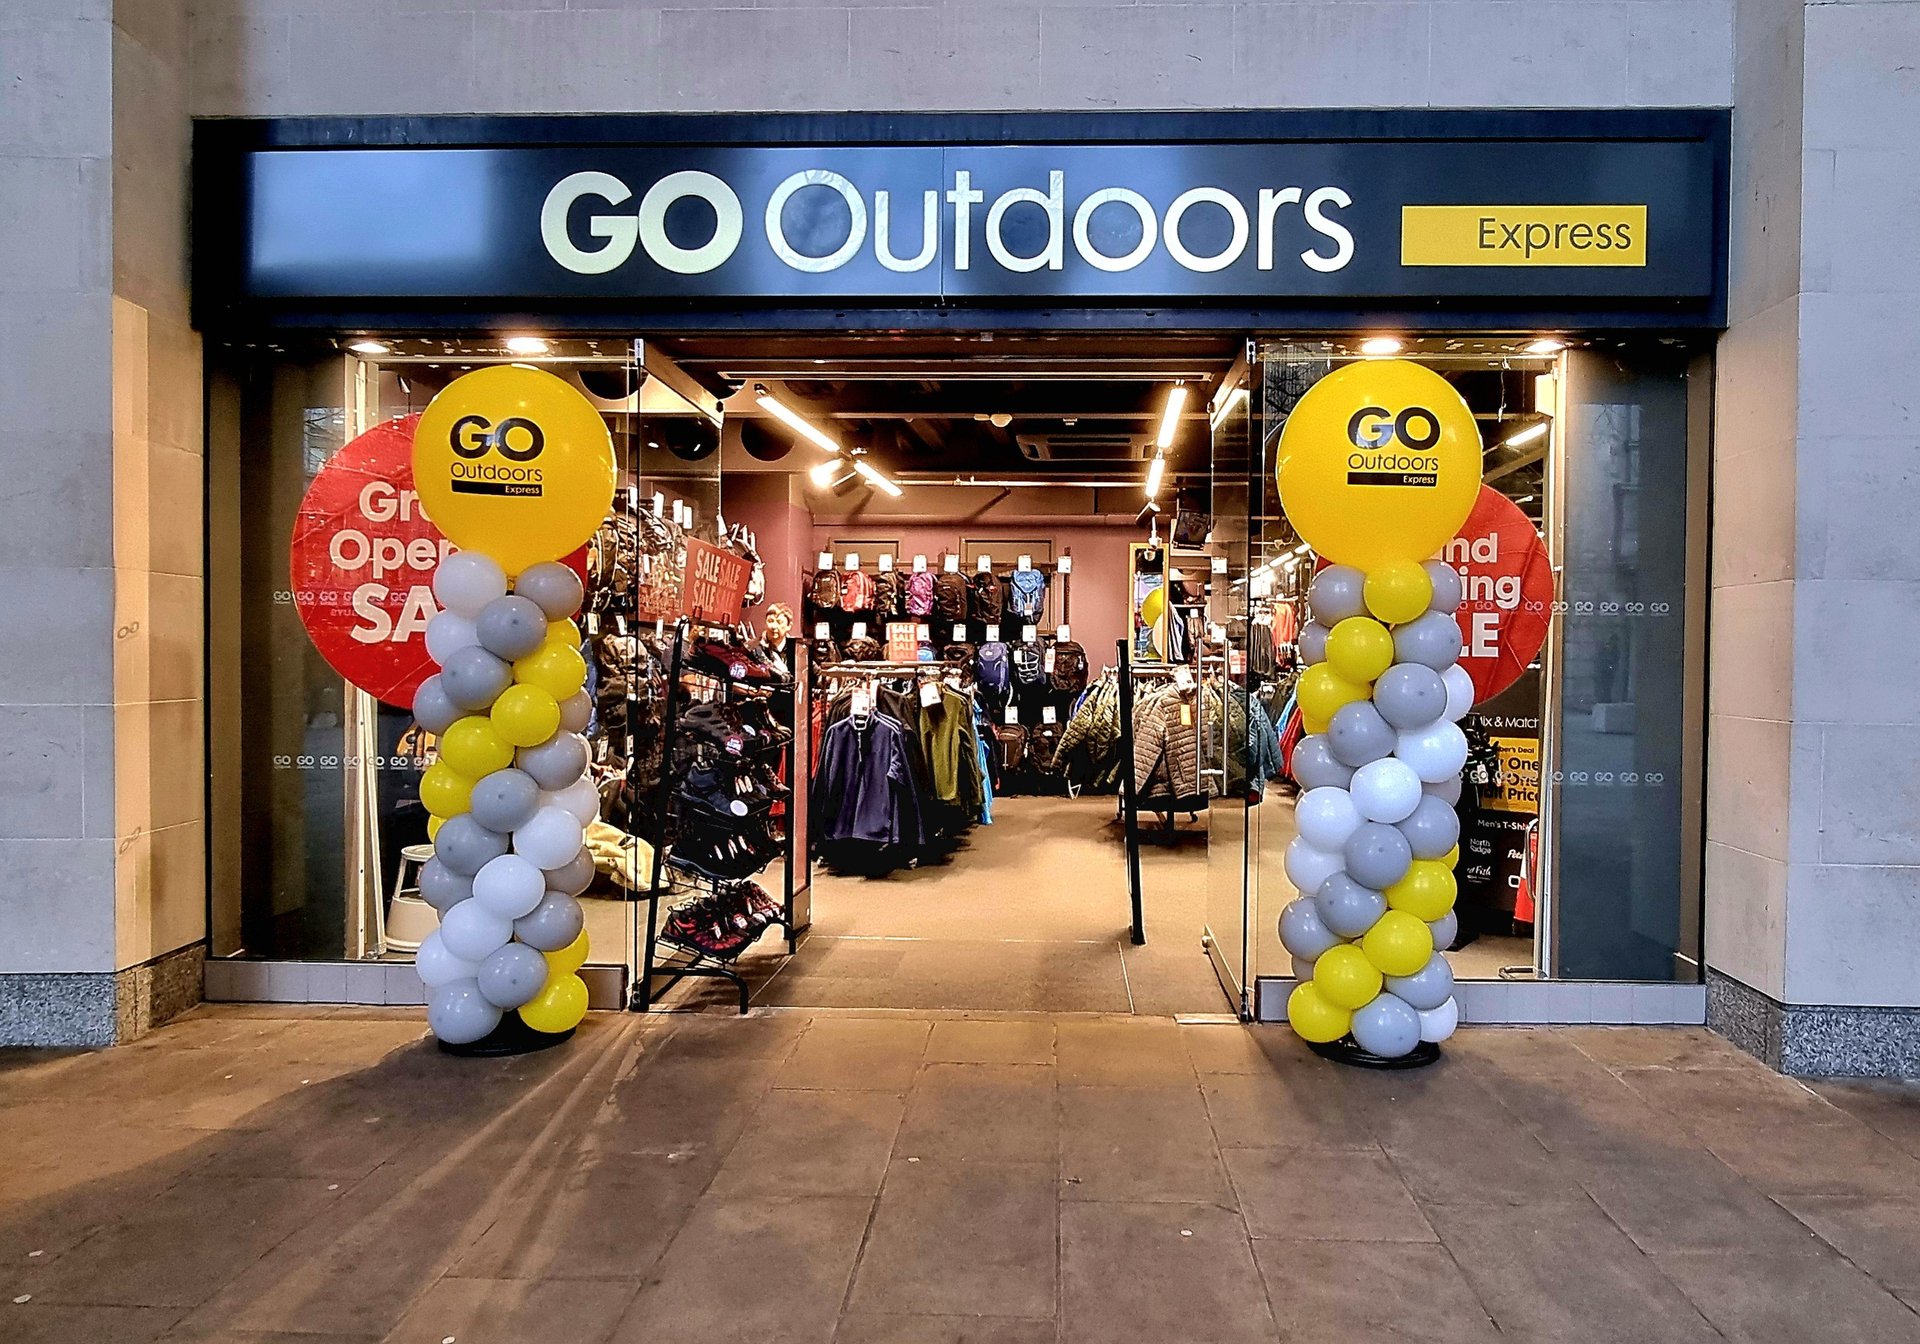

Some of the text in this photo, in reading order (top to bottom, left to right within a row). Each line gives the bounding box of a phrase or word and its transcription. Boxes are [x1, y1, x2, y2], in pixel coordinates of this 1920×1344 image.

[541, 168, 1355, 274] GO Outdoors
[1479, 217, 1632, 258] Express
[1347, 406, 1441, 451] GO
[449, 414, 545, 462] GO
[1347, 453, 1439, 471] Outdoors
[450, 461, 543, 482] Outdoors
[1402, 474, 1435, 486] Express
[504, 484, 540, 495] Express
[1436, 532, 1498, 563] nd
[694, 547, 742, 591] SALE SALE
[273, 591, 291, 601] GO
[297, 591, 315, 601] GO
[320, 591, 338, 601] GO
[692, 580, 717, 613] SALE
[1525, 601, 1543, 611] GO
[1550, 601, 1568, 611] GO
[1575, 601, 1593, 611] GO
[1600, 601, 1618, 611] GO
[1625, 602, 1644, 612] GO
[1650, 602, 1669, 612] GO
[1494, 716, 1503, 727] &
[273, 755, 291, 766] GO
[296, 755, 315, 766] GO
[320, 756, 338, 766] GO
[343, 756, 361, 766] GO
[367, 756, 385, 766] GO
[390, 756, 408, 767] GO
[1570, 771, 1588, 782] GO
[1595, 771, 1613, 782] GO
[1620, 772, 1638, 782] GO
[1645, 772, 1663, 782] GO
[1478, 819, 1501, 829] Men's
